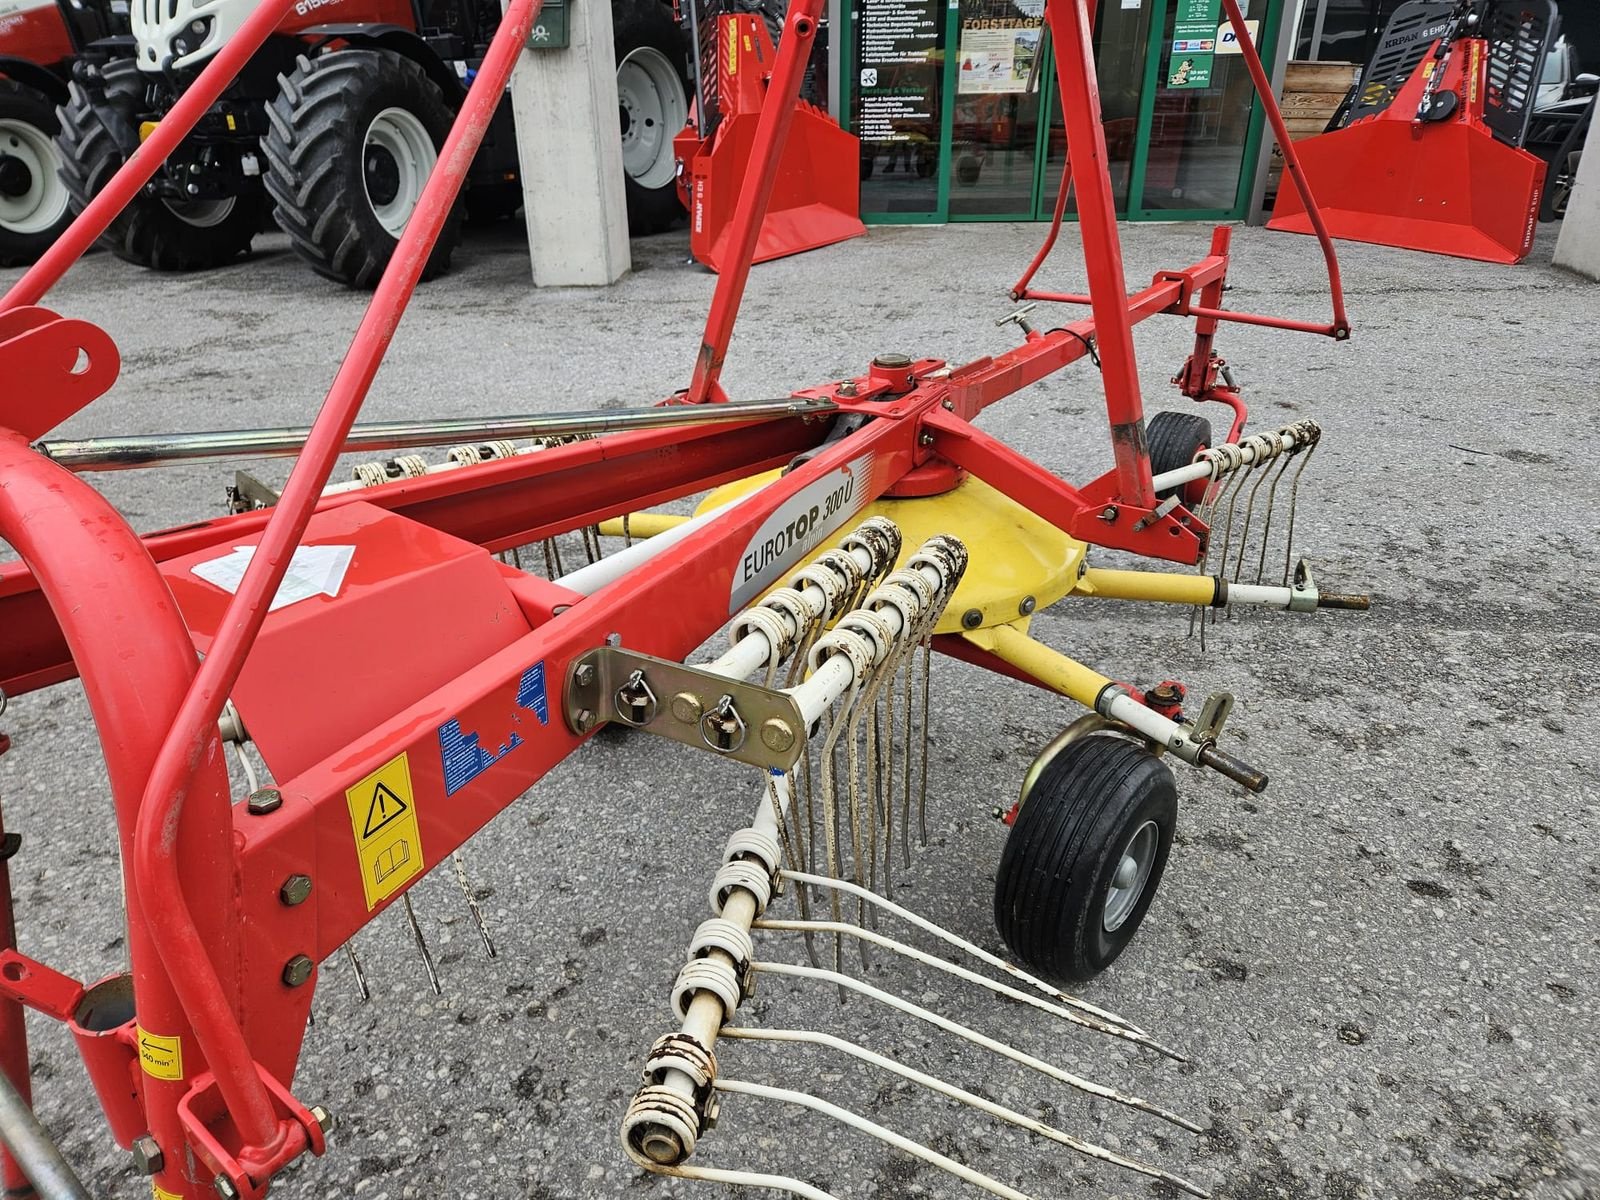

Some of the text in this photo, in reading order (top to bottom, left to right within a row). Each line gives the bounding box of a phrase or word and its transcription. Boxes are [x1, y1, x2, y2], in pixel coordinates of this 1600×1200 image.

[964, 18, 1042, 30] FORSTTAGE
[1429, 24, 1446, 35] EHP
[1384, 32, 1419, 49] KRPAN
[744, 476, 854, 582] EUROTOP 300 U
